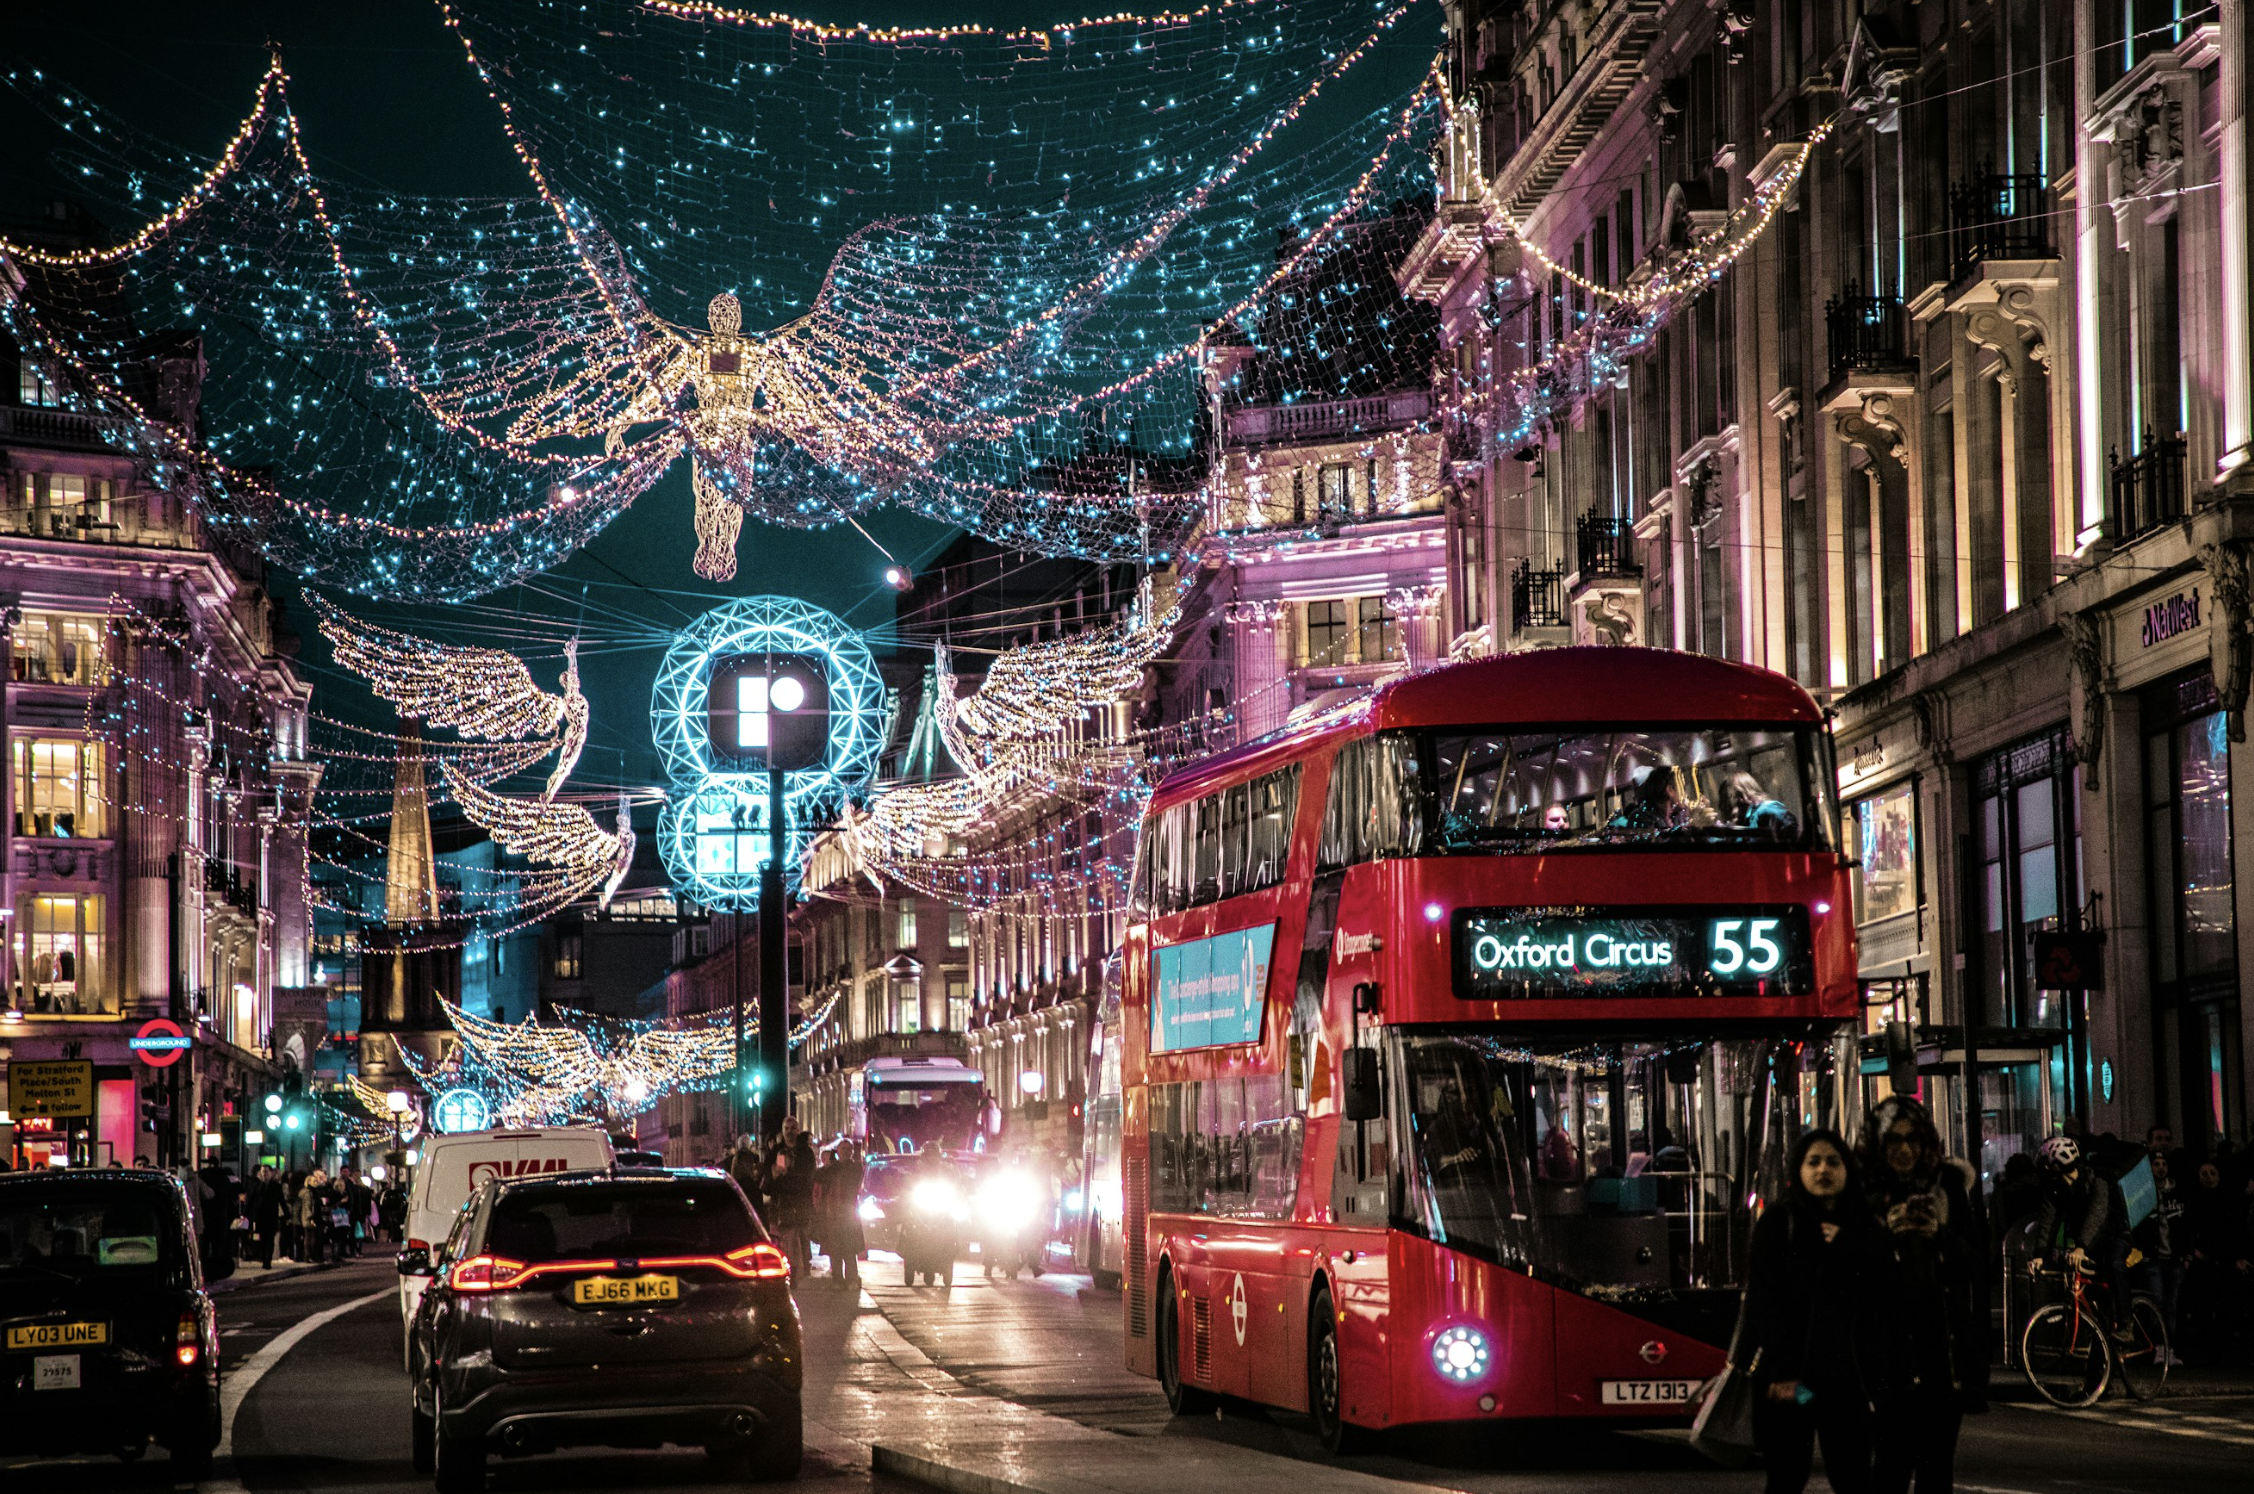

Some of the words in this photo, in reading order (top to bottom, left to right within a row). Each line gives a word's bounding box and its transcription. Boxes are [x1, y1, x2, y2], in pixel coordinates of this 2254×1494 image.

[2151, 587, 2201, 643] NatWest
[1475, 934, 1575, 969] Oxford
[1585, 934, 1673, 967] Circus
[1711, 919, 1780, 974] 55
[131, 1039, 188, 1047] UNDERGROUND
[17, 1067, 33, 1075] For
[37, 1065, 84, 1075] Stratford
[20, 1077, 81, 1087] Place/South
[25, 1088, 61, 1098] Molton
[64, 1088, 76, 1097] St
[51, 1103, 81, 1112] follow
[583, 1282, 630, 1300] EJ66
[635, 1281, 670, 1297] MKG
[14, 1327, 59, 1344] LY03
[65, 1325, 98, 1341] UNE
[1616, 1383, 1651, 1400] LTZ
[1656, 1383, 1688, 1400] 1313
